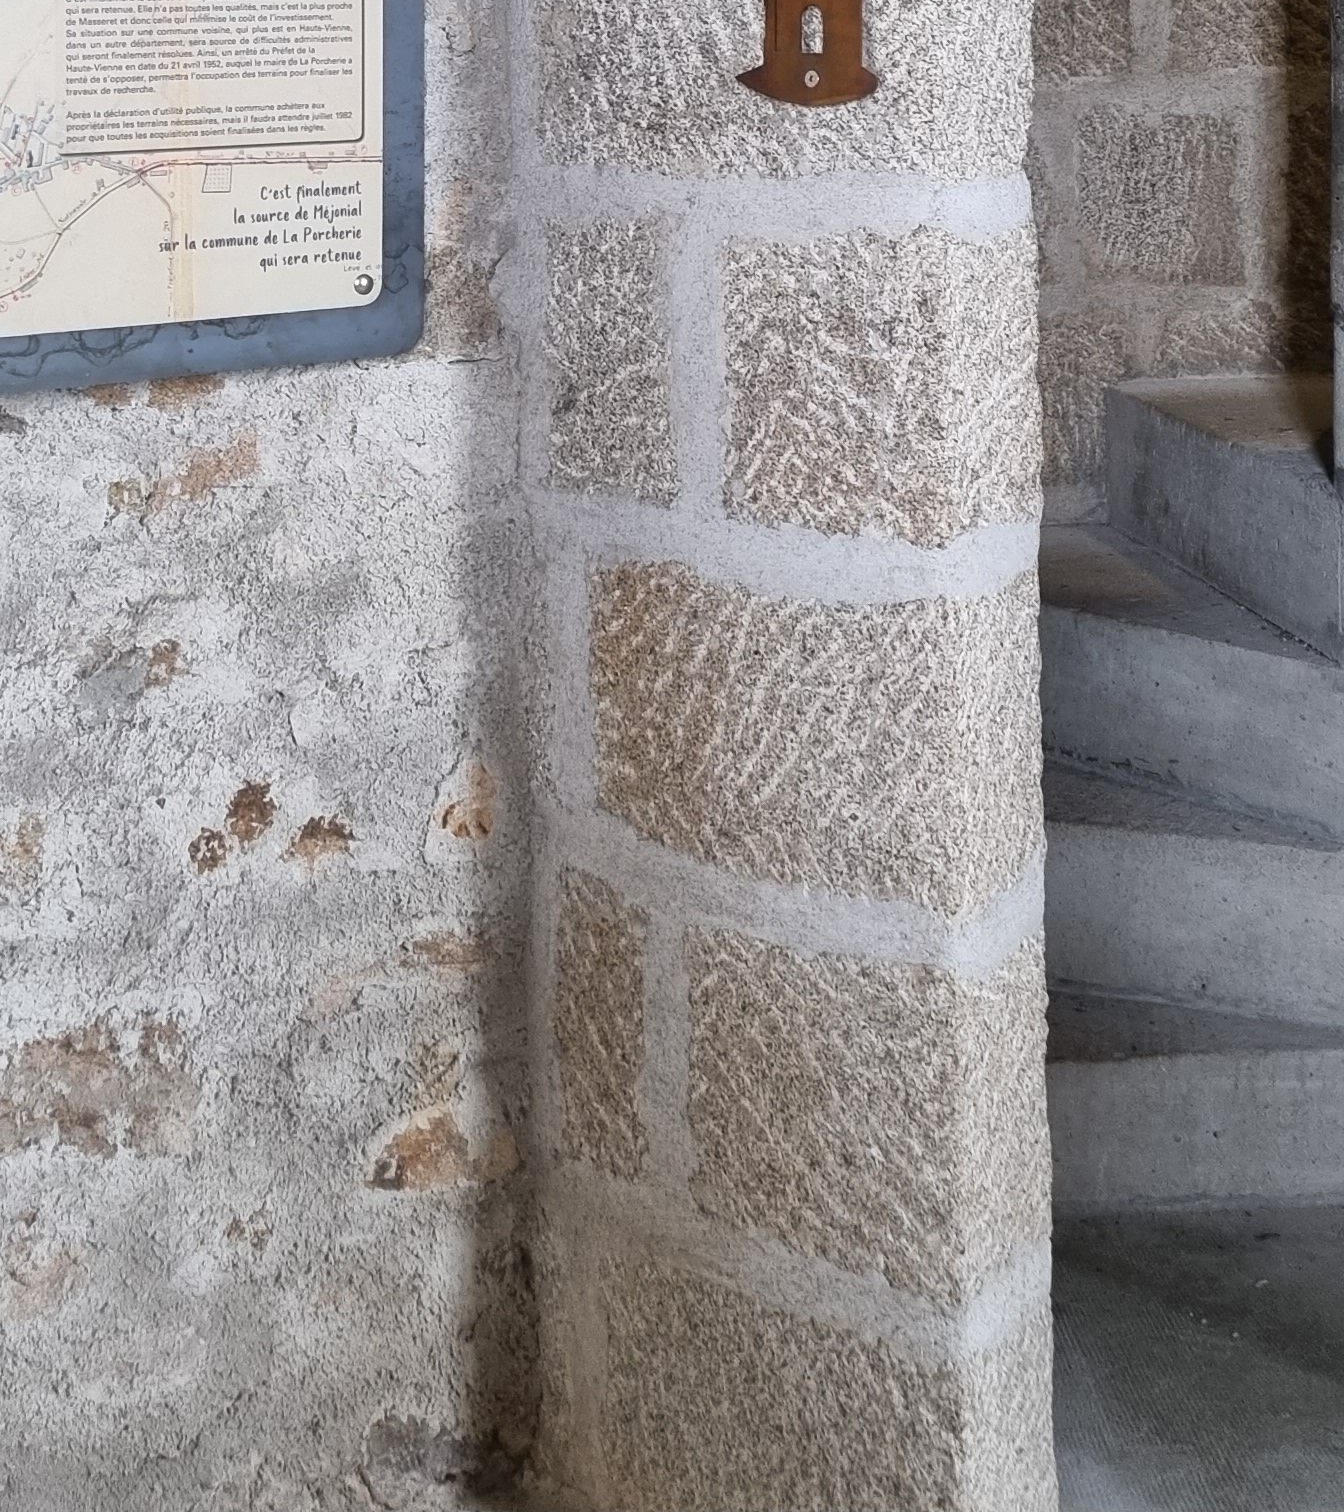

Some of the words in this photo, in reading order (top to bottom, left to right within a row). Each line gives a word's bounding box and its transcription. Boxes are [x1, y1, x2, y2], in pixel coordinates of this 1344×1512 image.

[260, 184, 291, 200] C'est
[296, 180, 361, 203] finalement
[233, 207, 245, 224] la
[251, 211, 289, 223] source
[294, 205, 308, 220] de
[313, 200, 361, 223] Méjonial
[158, 236, 179, 252] sur
[184, 234, 196, 249] la
[201, 236, 258, 248] commune
[263, 229, 278, 244] de
[283, 229, 298, 243] La
[303, 226, 361, 242] Porcherie
[259, 253, 277, 272] qui
[282, 254, 308, 265] sera
[313, 248, 361, 263] retenue
